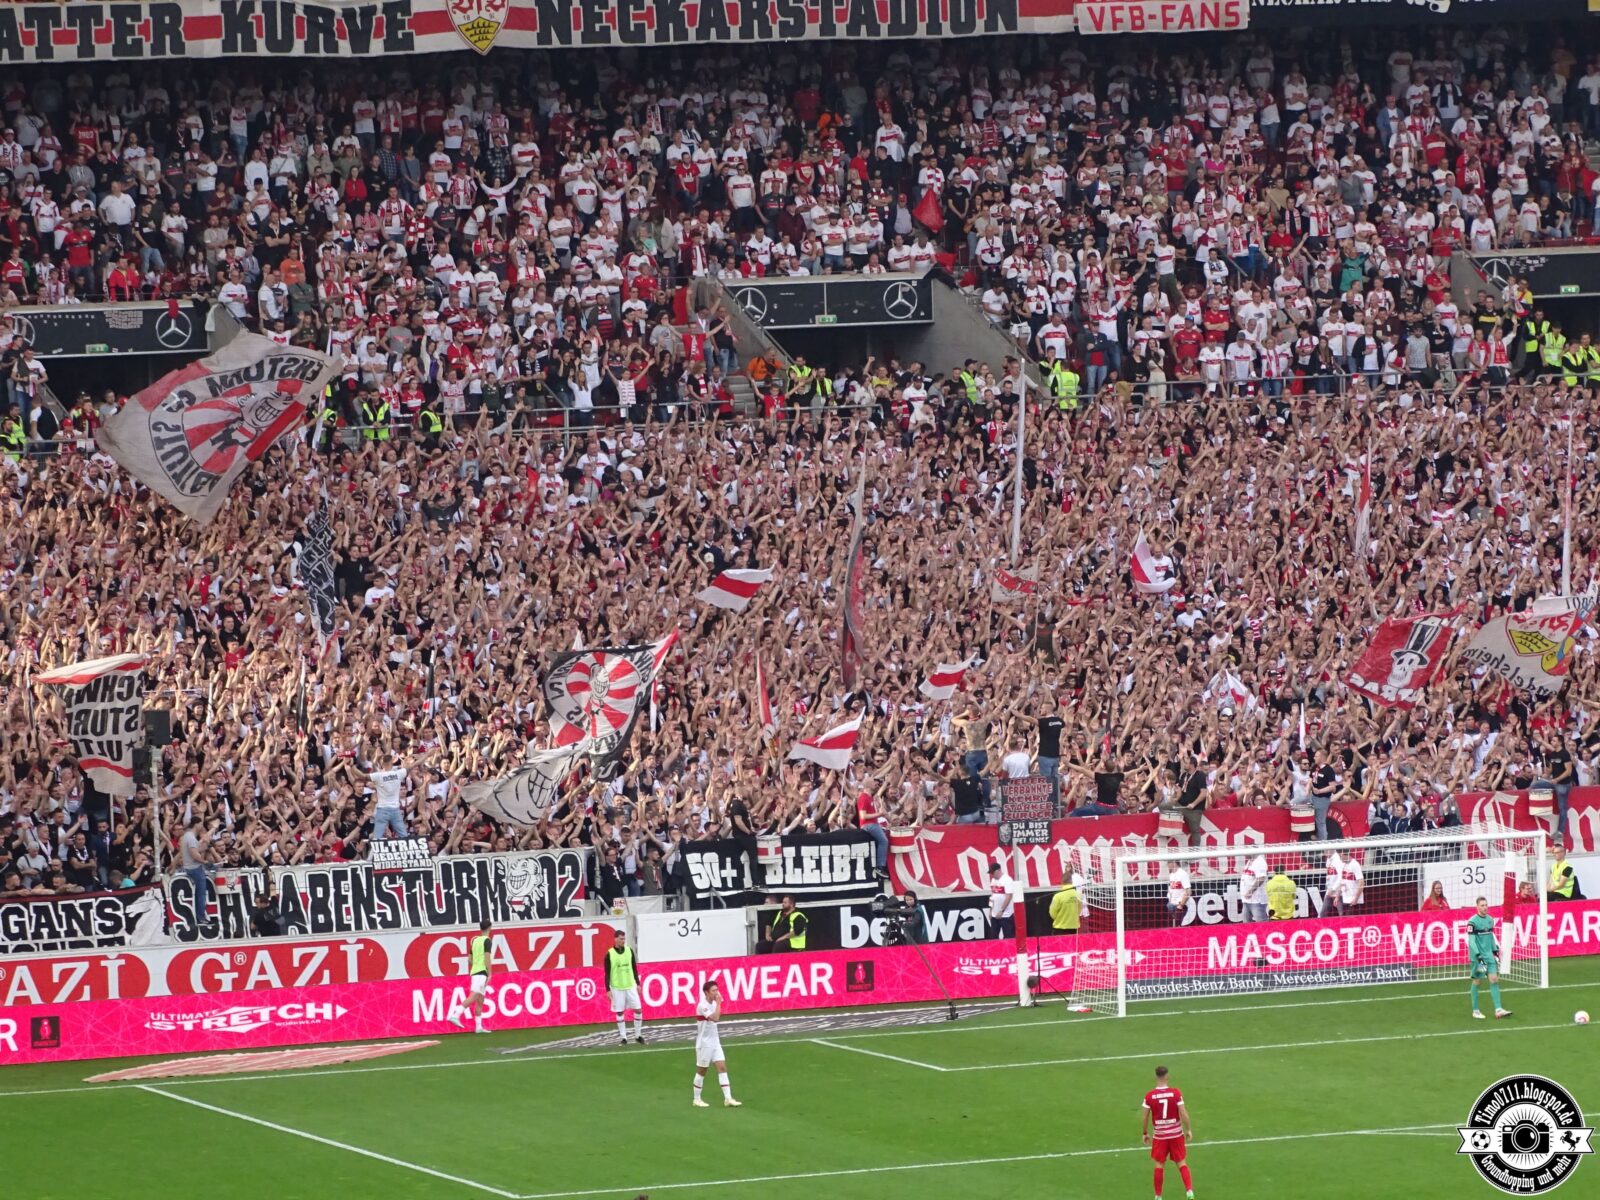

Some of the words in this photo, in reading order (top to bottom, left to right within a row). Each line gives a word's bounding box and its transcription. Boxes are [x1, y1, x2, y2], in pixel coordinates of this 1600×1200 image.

[1091, 1, 1241, 32] VFB-FANS
[221, 0, 415, 55] KURVE
[536, 0, 1018, 46] NECKARSTADION
[1003, 783, 1053, 796] VERBANNTE
[1012, 829, 1049, 838] IMMER
[1029, 821, 1049, 829] BIST
[370, 837, 429, 853] ULTRAS
[373, 849, 430, 862] BEDEUTET
[373, 858, 432, 870] WIDERSTAND
[685, 849, 754, 890] 50+1
[765, 840, 877, 885] BLEIBT!
[1462, 865, 1486, 885] 35
[535, 852, 584, 919] 02
[1274, 969, 1373, 985] Mercedes-Benz
[1376, 966, 1411, 980] Bank
[1126, 978, 1225, 995] Mercedes-Benz
[1229, 977, 1264, 989] Bank
[152, 1002, 333, 1032] STRETCH
[1158, 1098, 1169, 1120] 7
